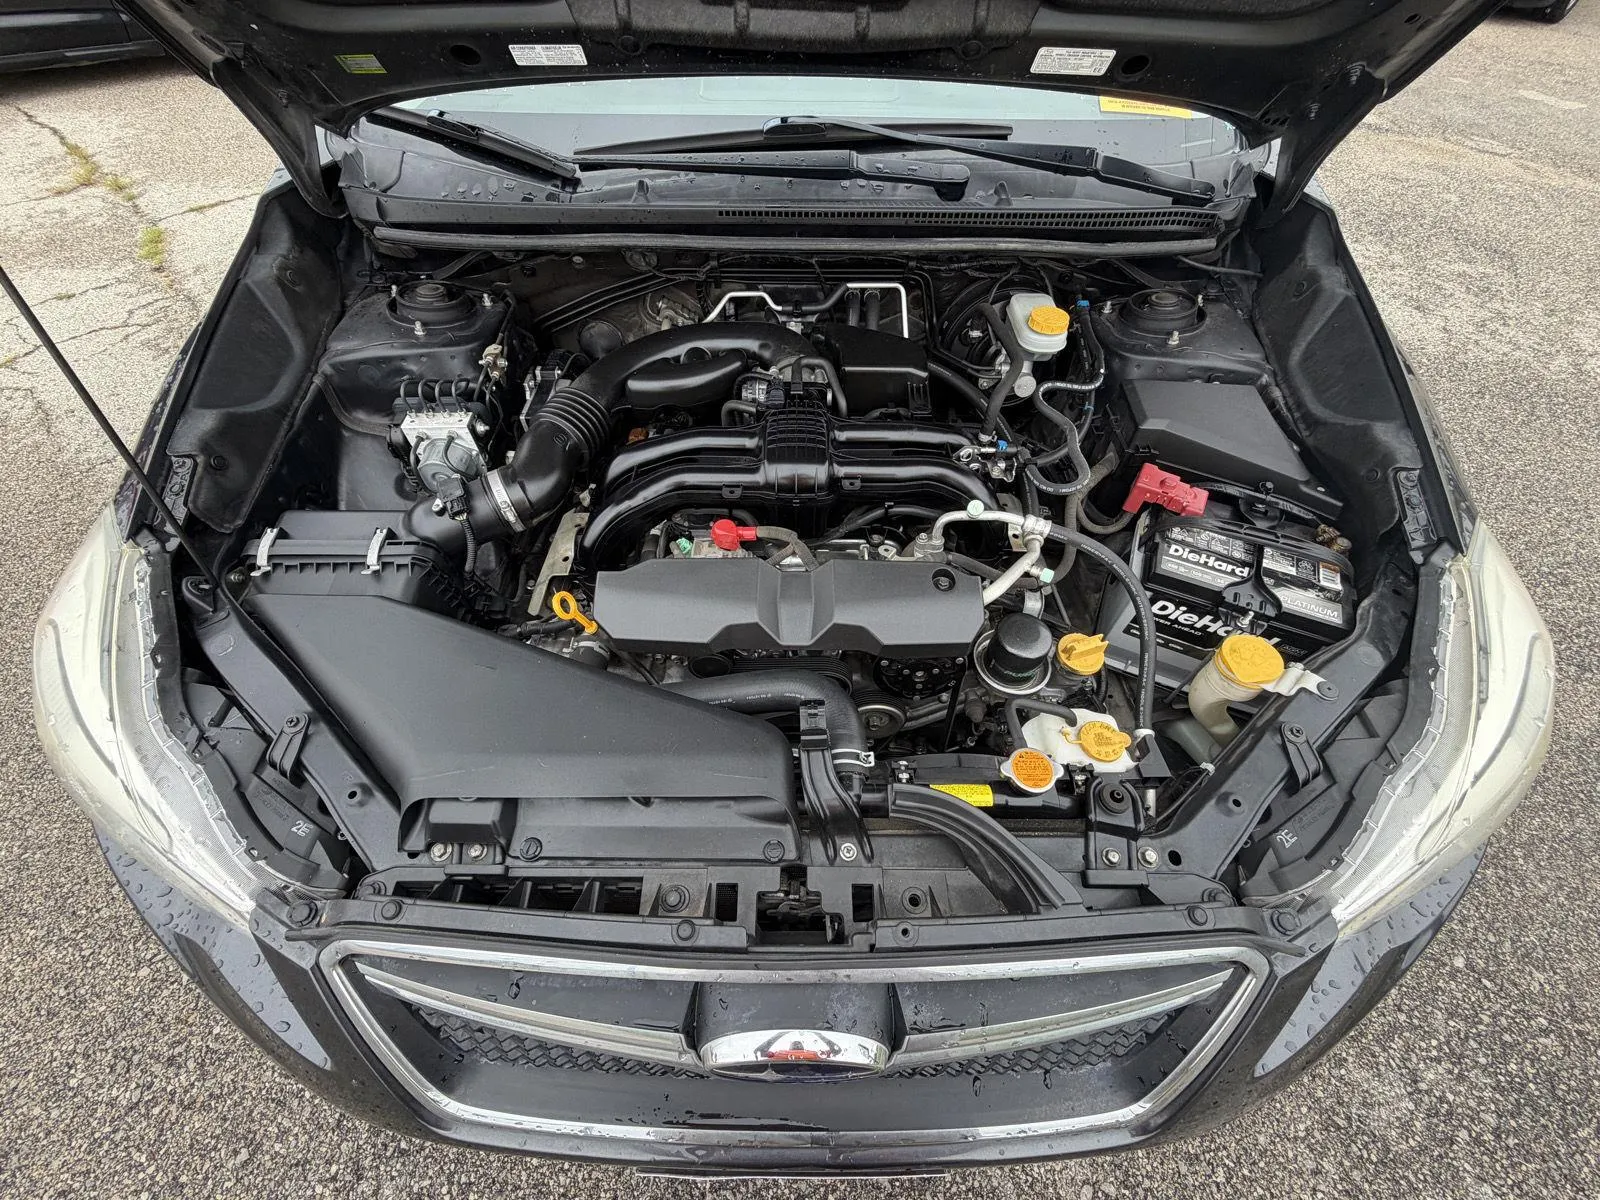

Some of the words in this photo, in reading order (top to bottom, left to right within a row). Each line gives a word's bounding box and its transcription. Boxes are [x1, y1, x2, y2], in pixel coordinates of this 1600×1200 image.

[1168, 543, 1250, 578] DieHard
[1280, 595, 1339, 618] PLATINUM
[1151, 600, 1281, 646] DieHa
[1171, 624, 1202, 636] AHEAD
[291, 820, 314, 837] 2E
[1276, 829, 1298, 849] 2E
